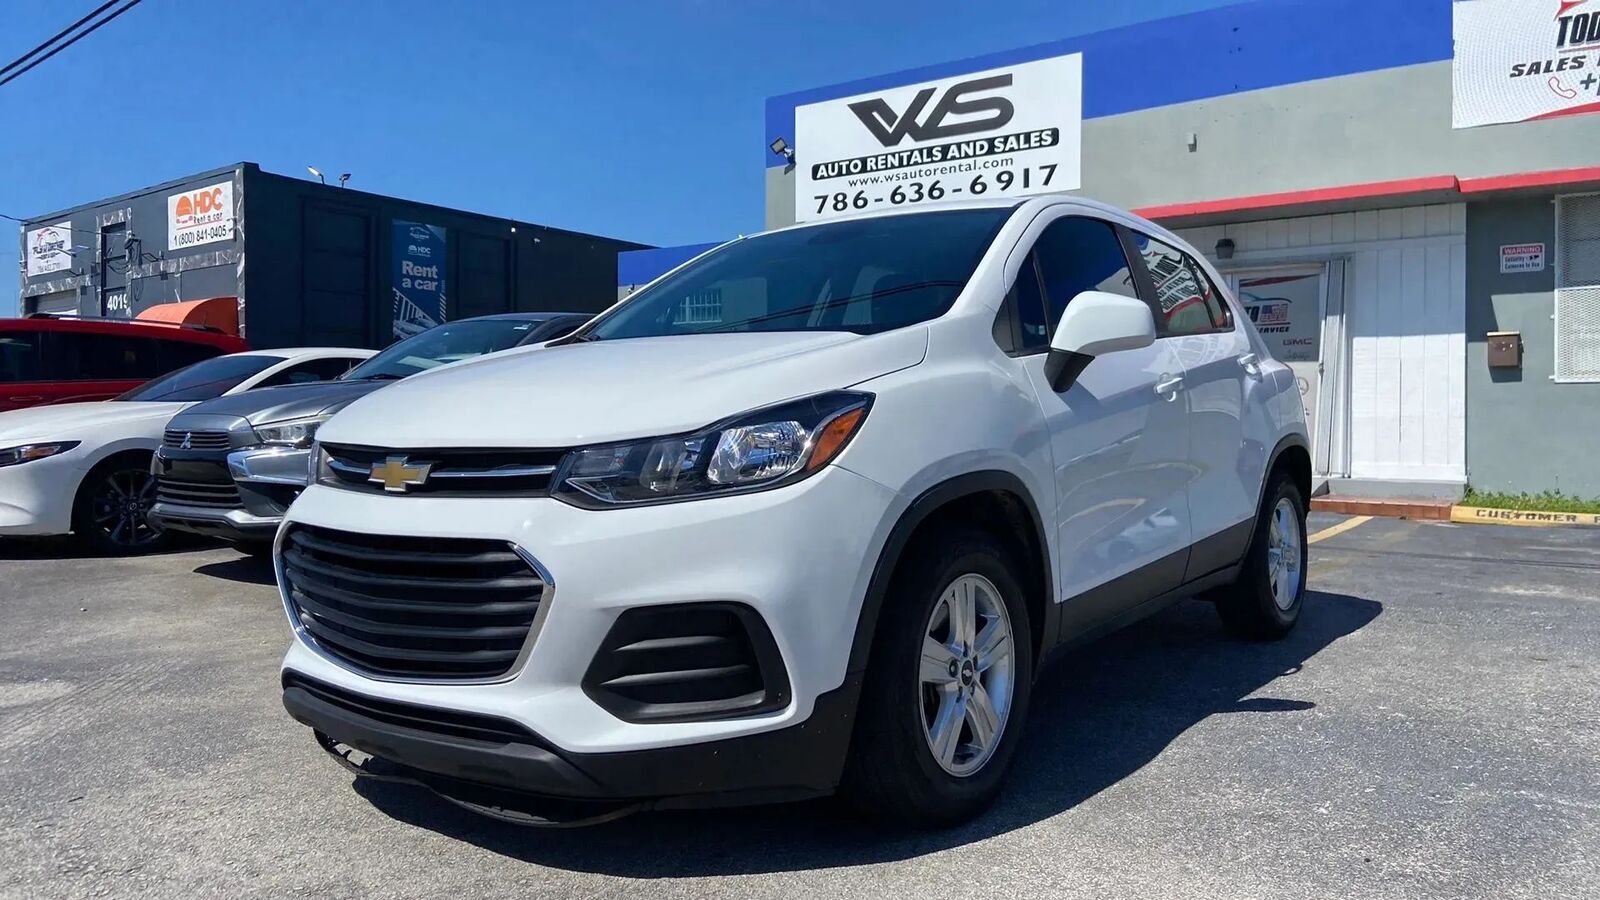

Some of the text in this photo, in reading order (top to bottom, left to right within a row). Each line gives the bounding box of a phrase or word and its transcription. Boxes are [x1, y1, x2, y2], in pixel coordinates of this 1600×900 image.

[1509, 55, 1587, 78] SALES
[847, 73, 1015, 148] WS
[816, 129, 1053, 179] AUTO RENTALS AND SALES
[848, 157, 1014, 188] www.wsautorental.com
[814, 163, 1058, 214] 786-636-6917
[193, 187, 223, 215] HDC
[193, 214, 206, 224] Rent
[213, 212, 223, 220] car
[174, 224, 227, 246] 1 (800) 841-0405
[1503, 245, 1542, 255] WARNING
[401, 260, 438, 279] Rent
[402, 277, 438, 291] a car
[1283, 338, 1312, 346] GMC
[1476, 509, 1577, 522] CUSTOMER
